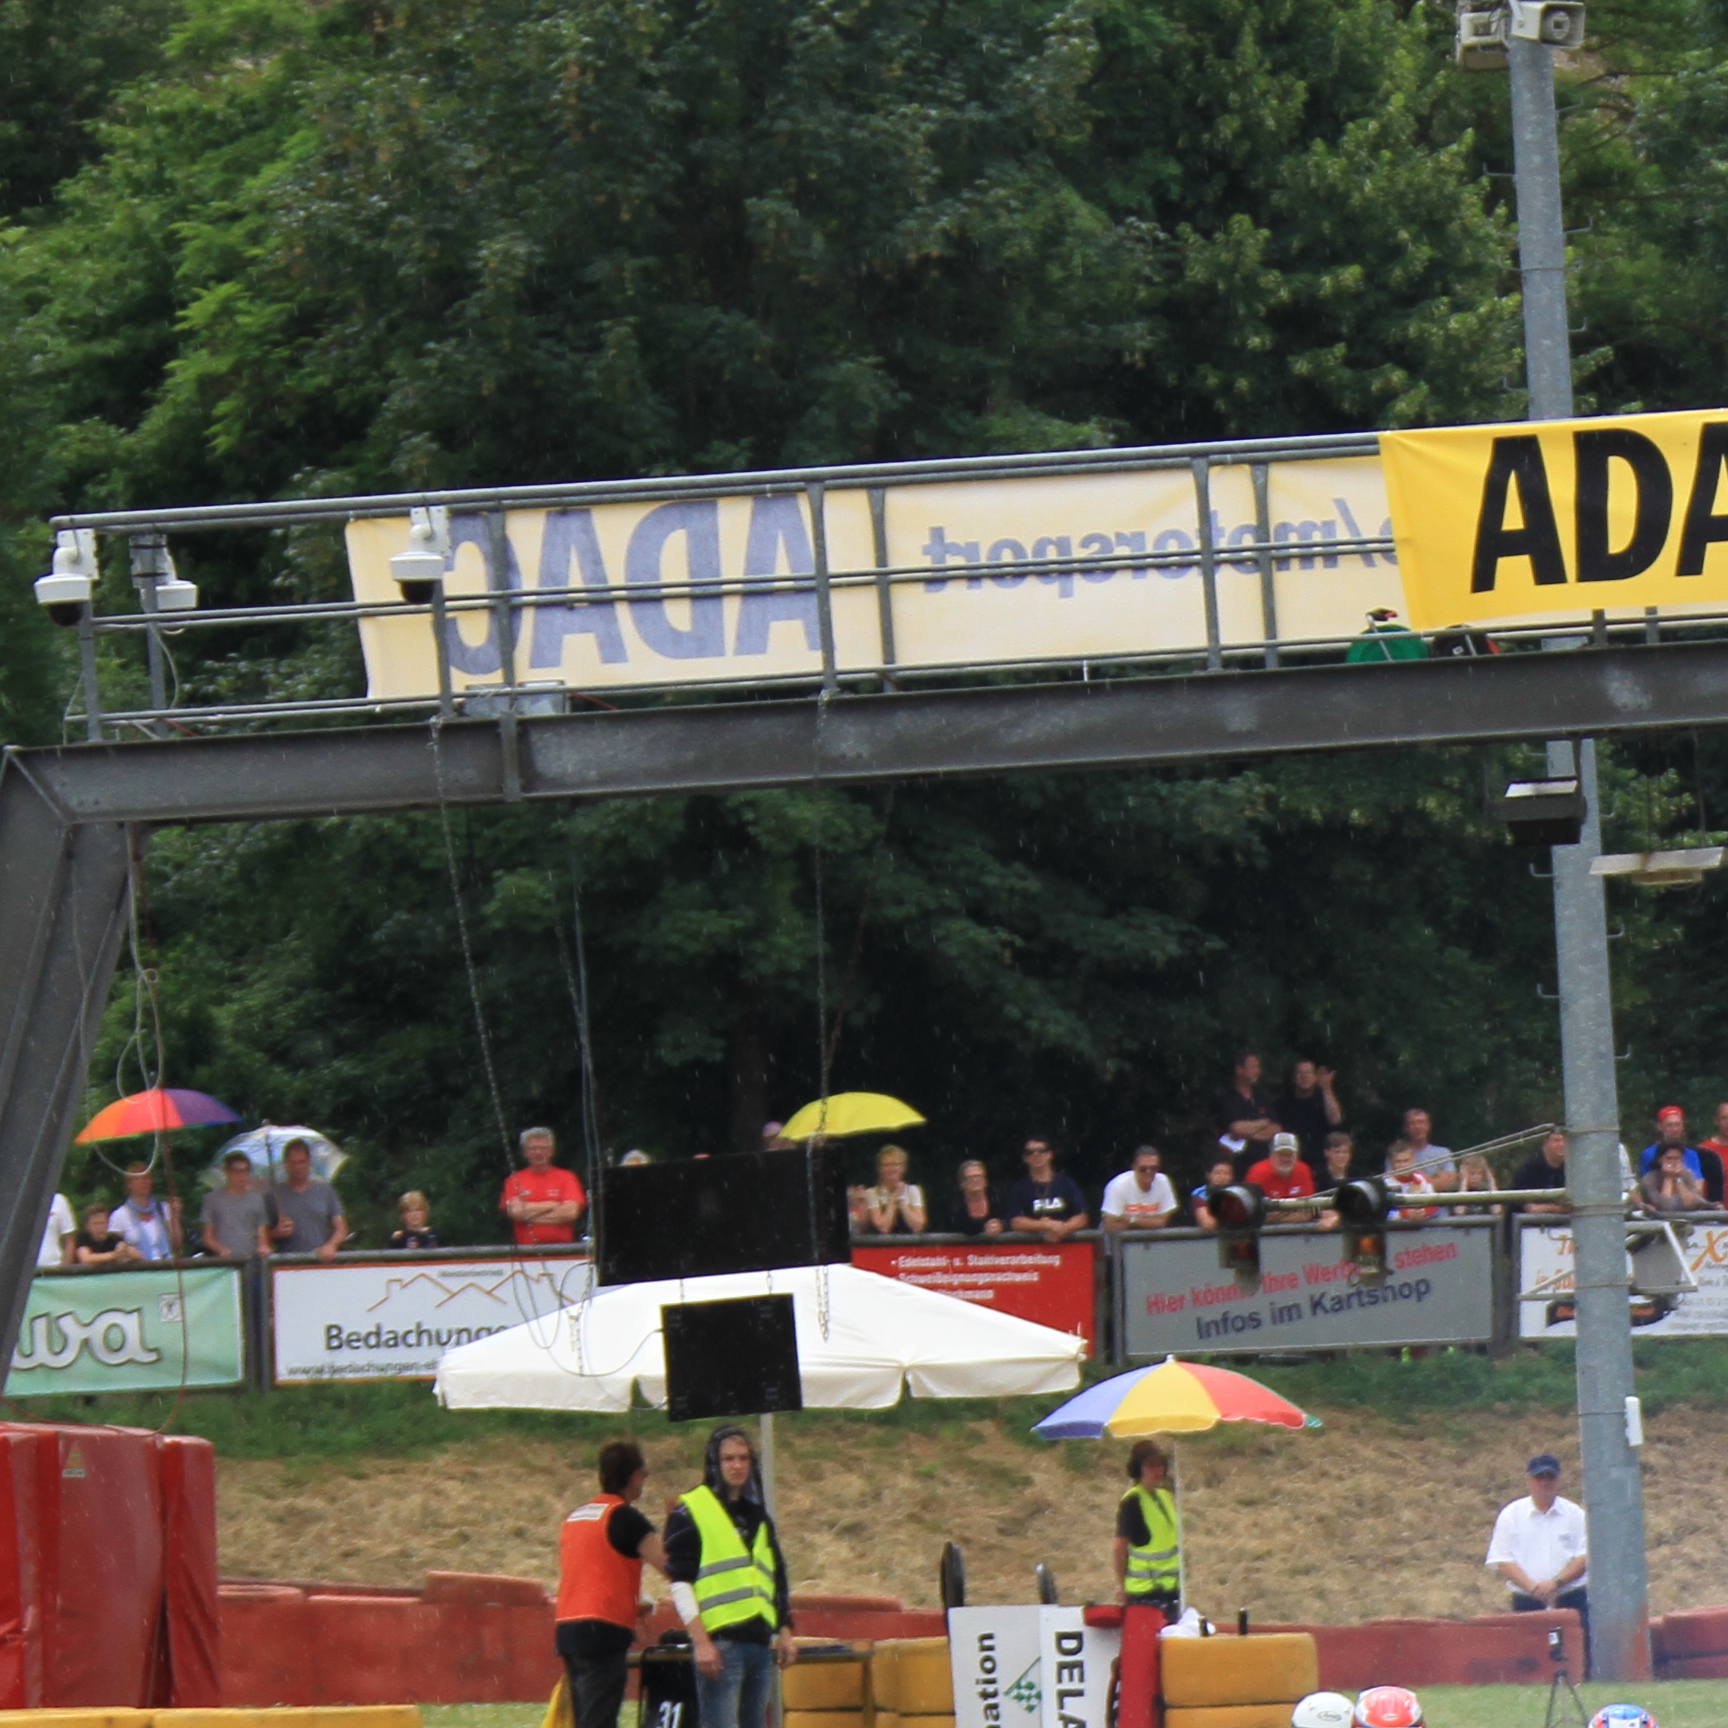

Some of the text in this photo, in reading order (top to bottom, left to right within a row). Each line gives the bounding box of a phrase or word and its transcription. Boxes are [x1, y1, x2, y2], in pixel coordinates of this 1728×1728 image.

[1146, 1294, 1186, 1315] Hier
[1262, 1271, 1300, 1294] Ihre
[1394, 1241, 1458, 1270] stehen
[1196, 1276, 1432, 1340] Infos im Kartshop
